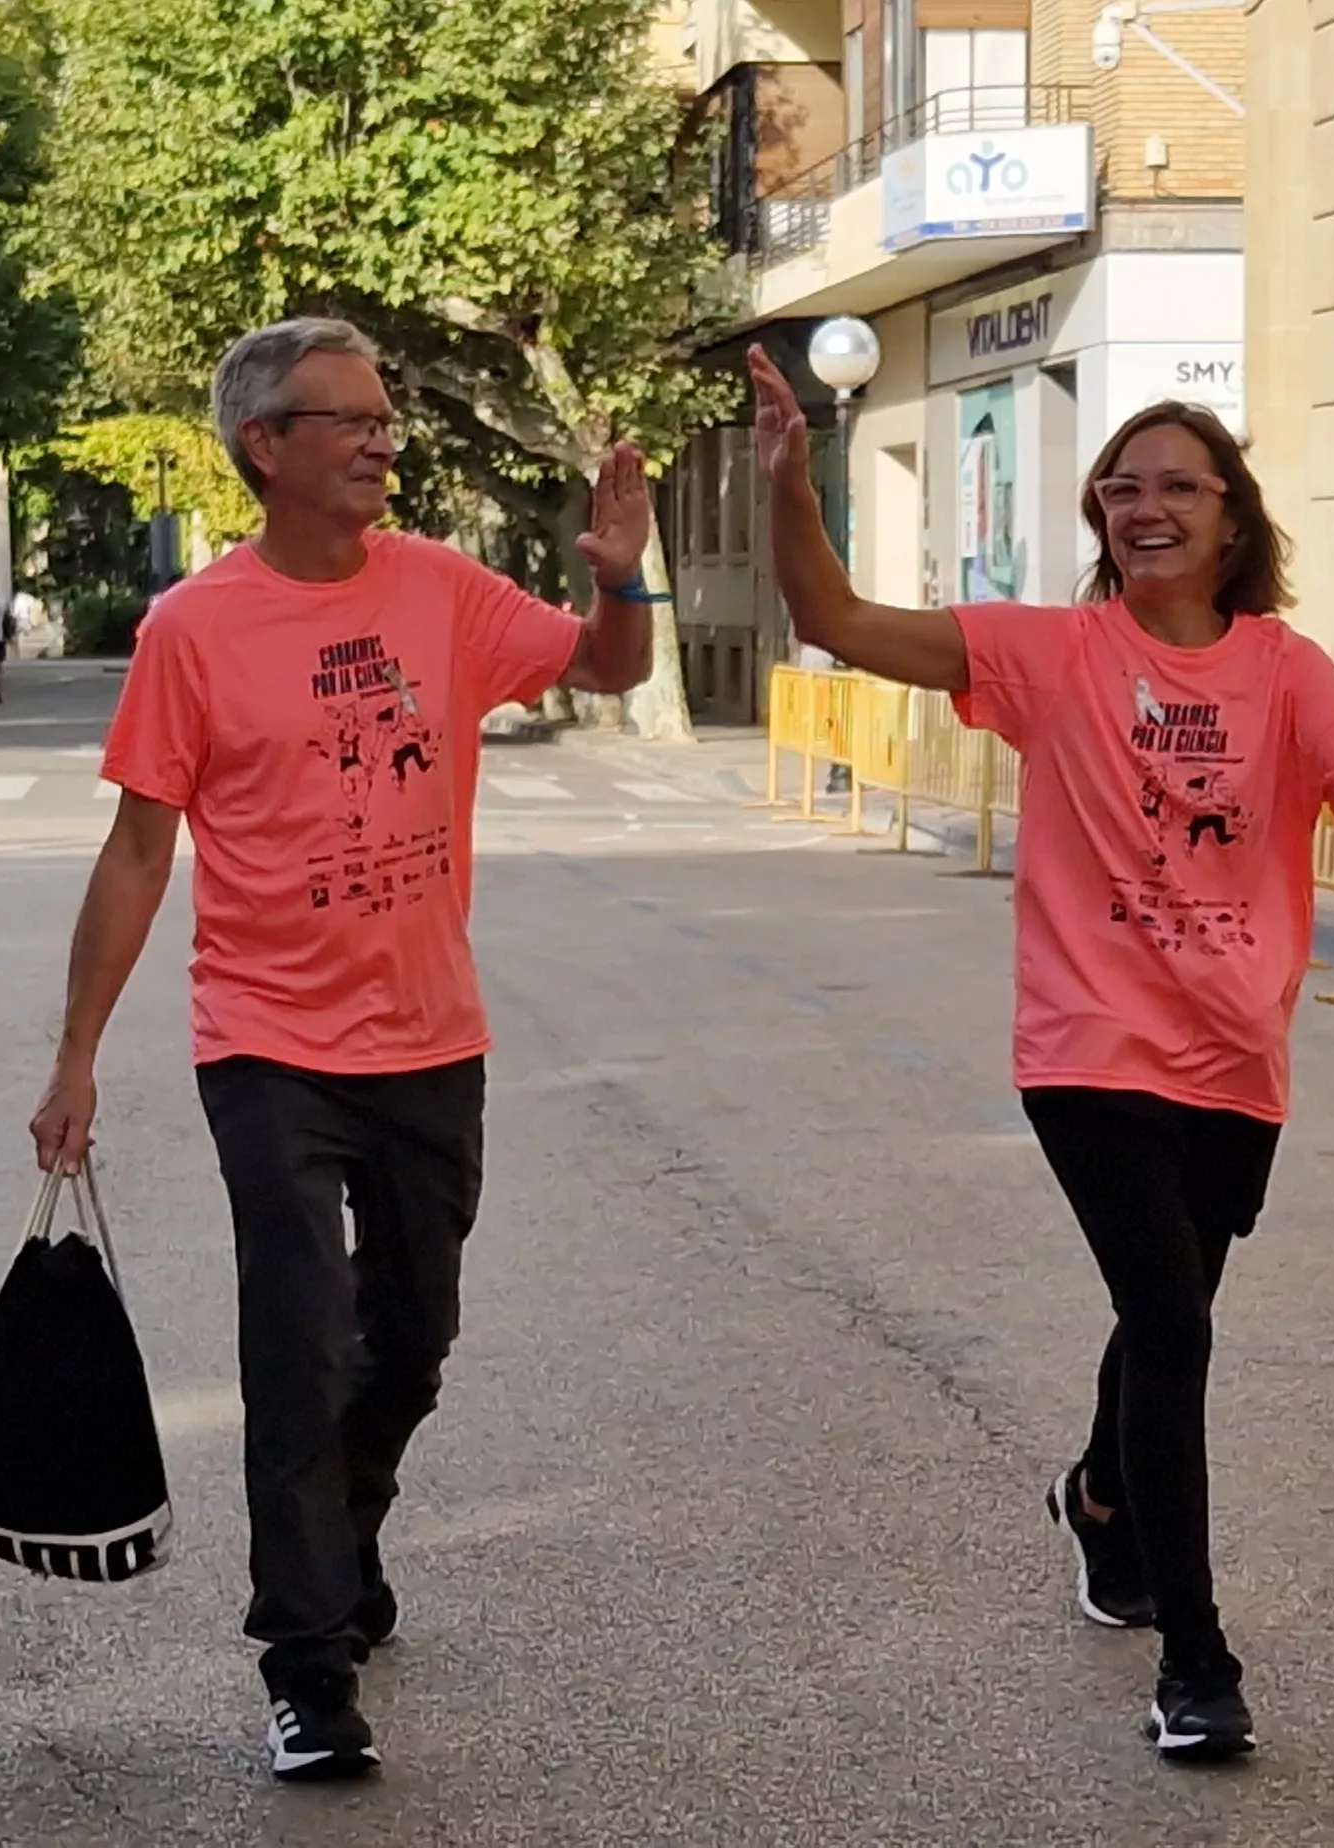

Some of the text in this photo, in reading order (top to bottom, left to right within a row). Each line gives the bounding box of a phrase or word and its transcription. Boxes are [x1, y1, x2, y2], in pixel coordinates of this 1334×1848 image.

[966, 292, 1052, 359] VITALDENT
[1175, 360, 1235, 384] SMY
[312, 670, 336, 699] POR
[339, 667, 352, 693] LA
[1132, 725, 1228, 753] POR LA CIENCIA
